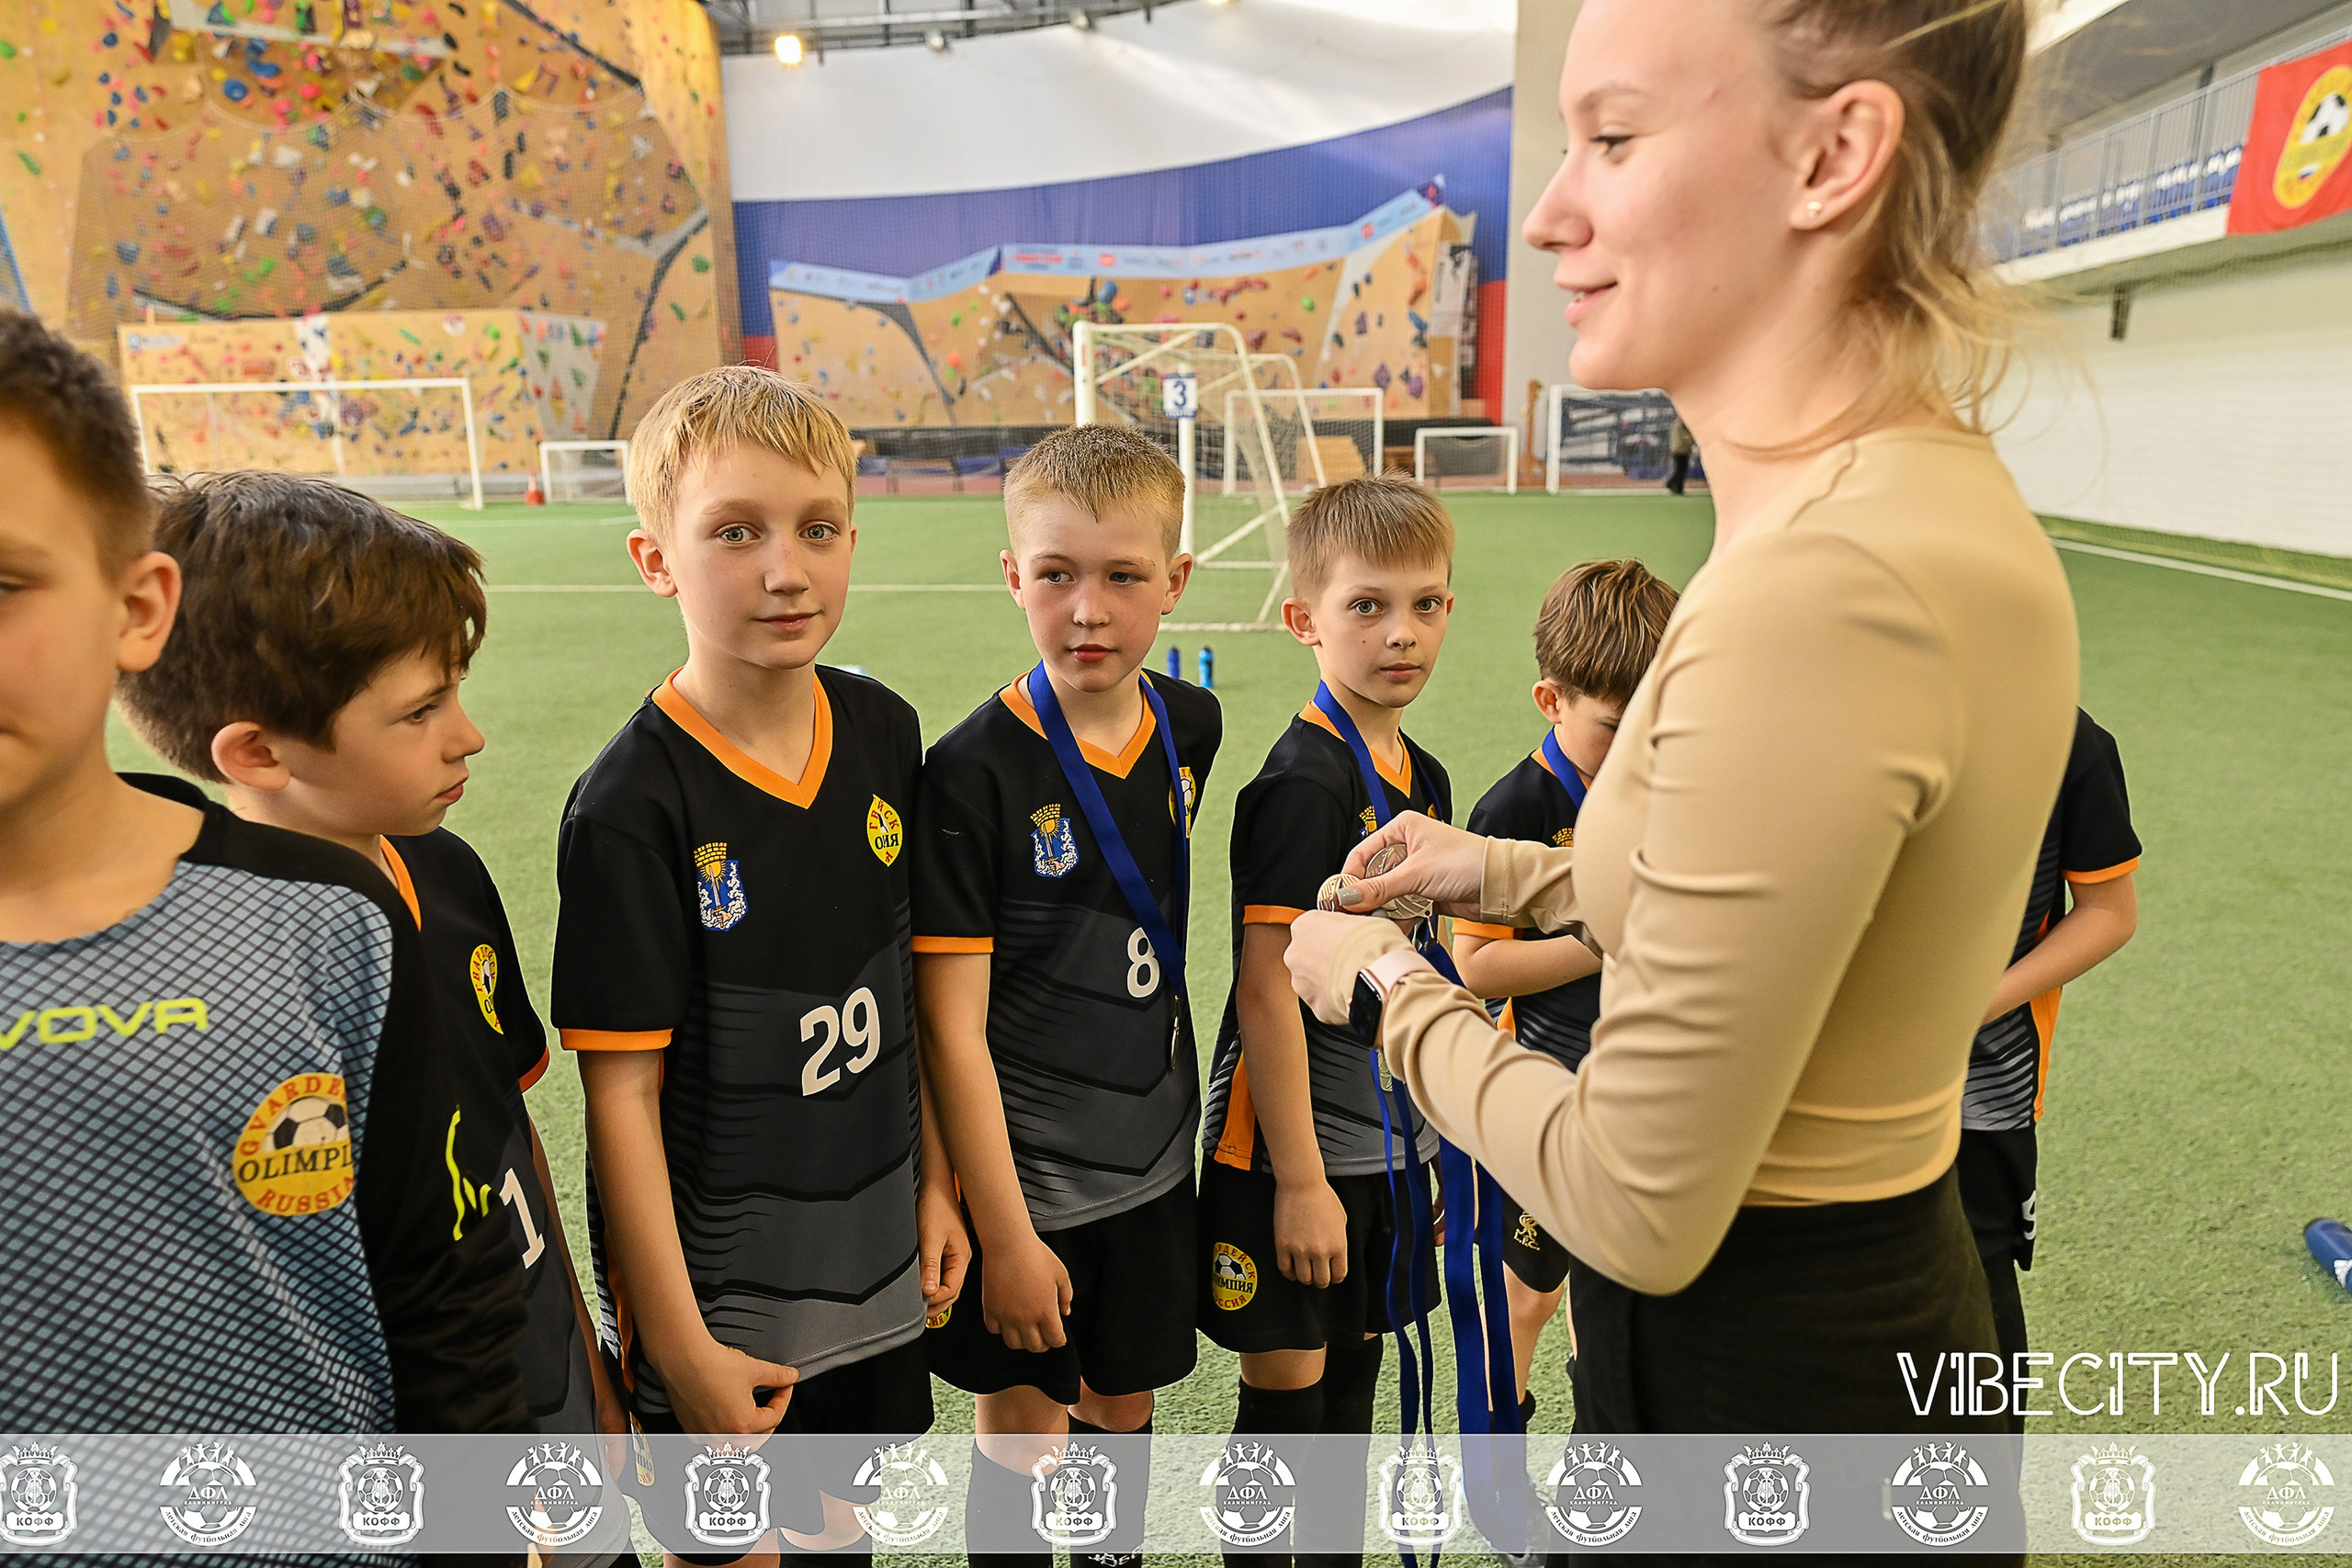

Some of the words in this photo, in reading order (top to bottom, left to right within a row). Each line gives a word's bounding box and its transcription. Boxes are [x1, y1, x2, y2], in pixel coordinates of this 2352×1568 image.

[1174, 380, 1187, 409] 3
[1127, 927, 1160, 998] 8
[799, 986, 881, 1097] 29
[238, 1145, 354, 1183] OLIMPI
[499, 1167, 546, 1269] 1
